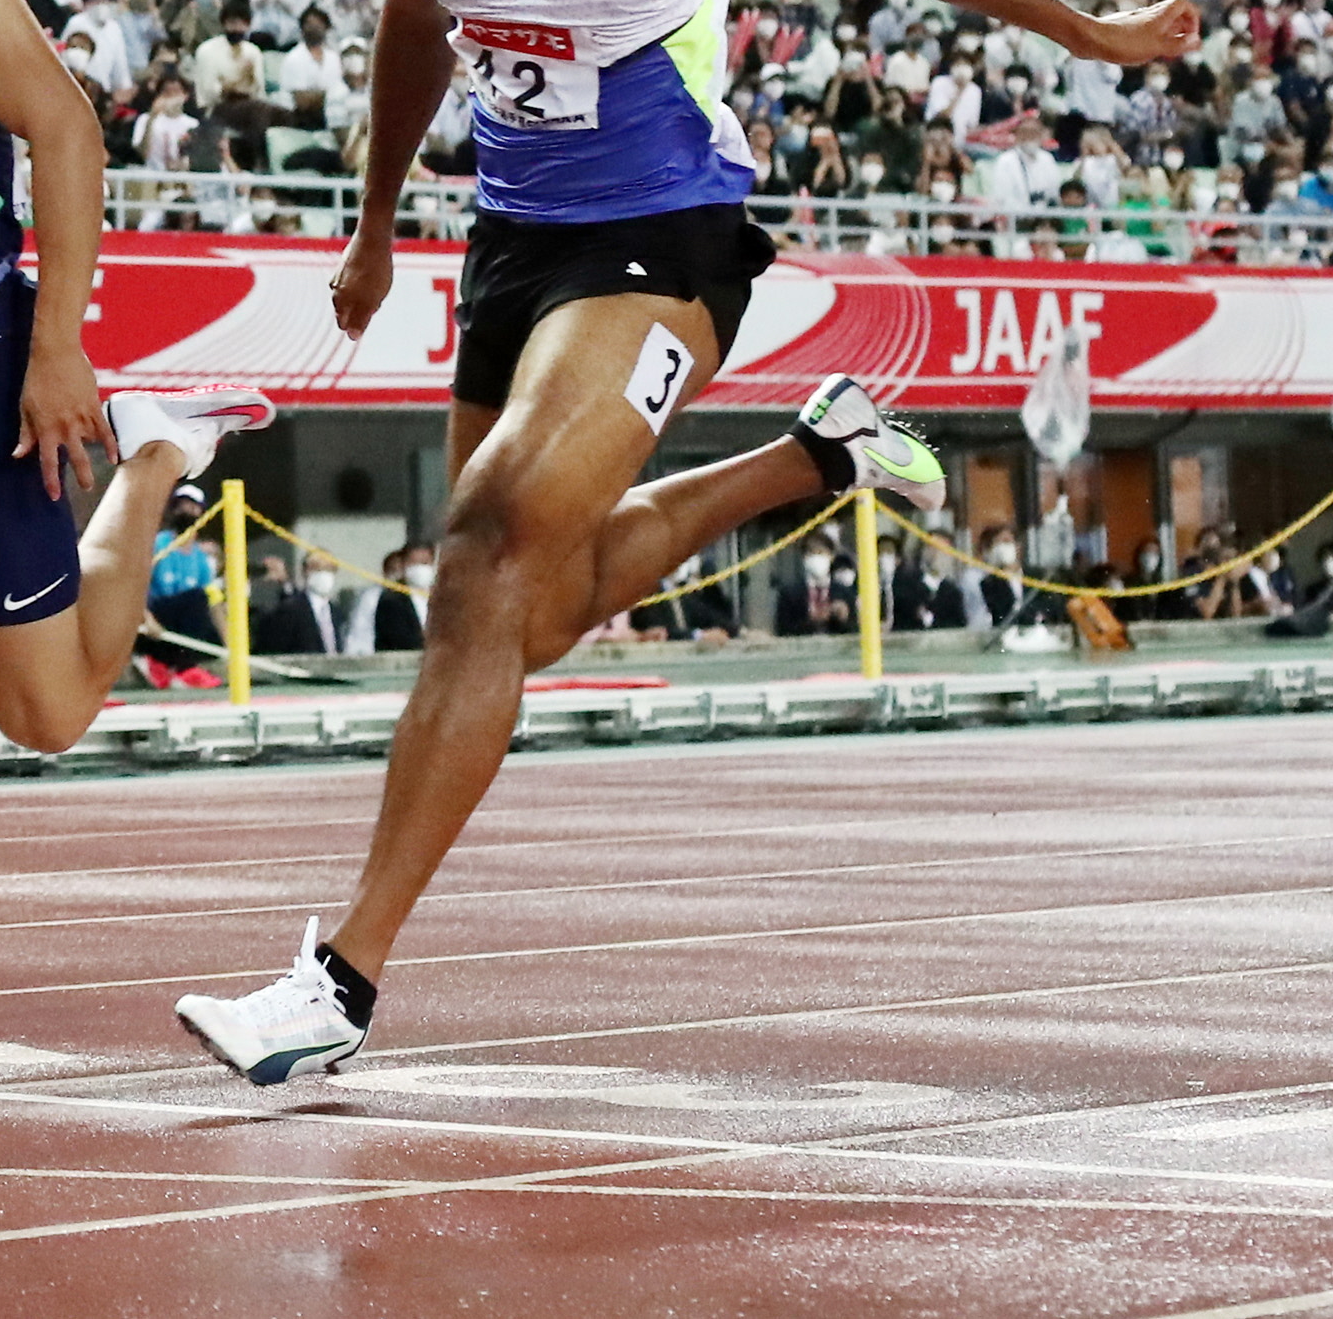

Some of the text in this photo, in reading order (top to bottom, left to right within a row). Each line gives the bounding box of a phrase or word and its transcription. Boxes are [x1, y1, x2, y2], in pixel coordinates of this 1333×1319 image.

[464, 23, 567, 52] ヤマザキ
[950, 288, 1104, 374] JAAF
[645, 349, 681, 414] 3
